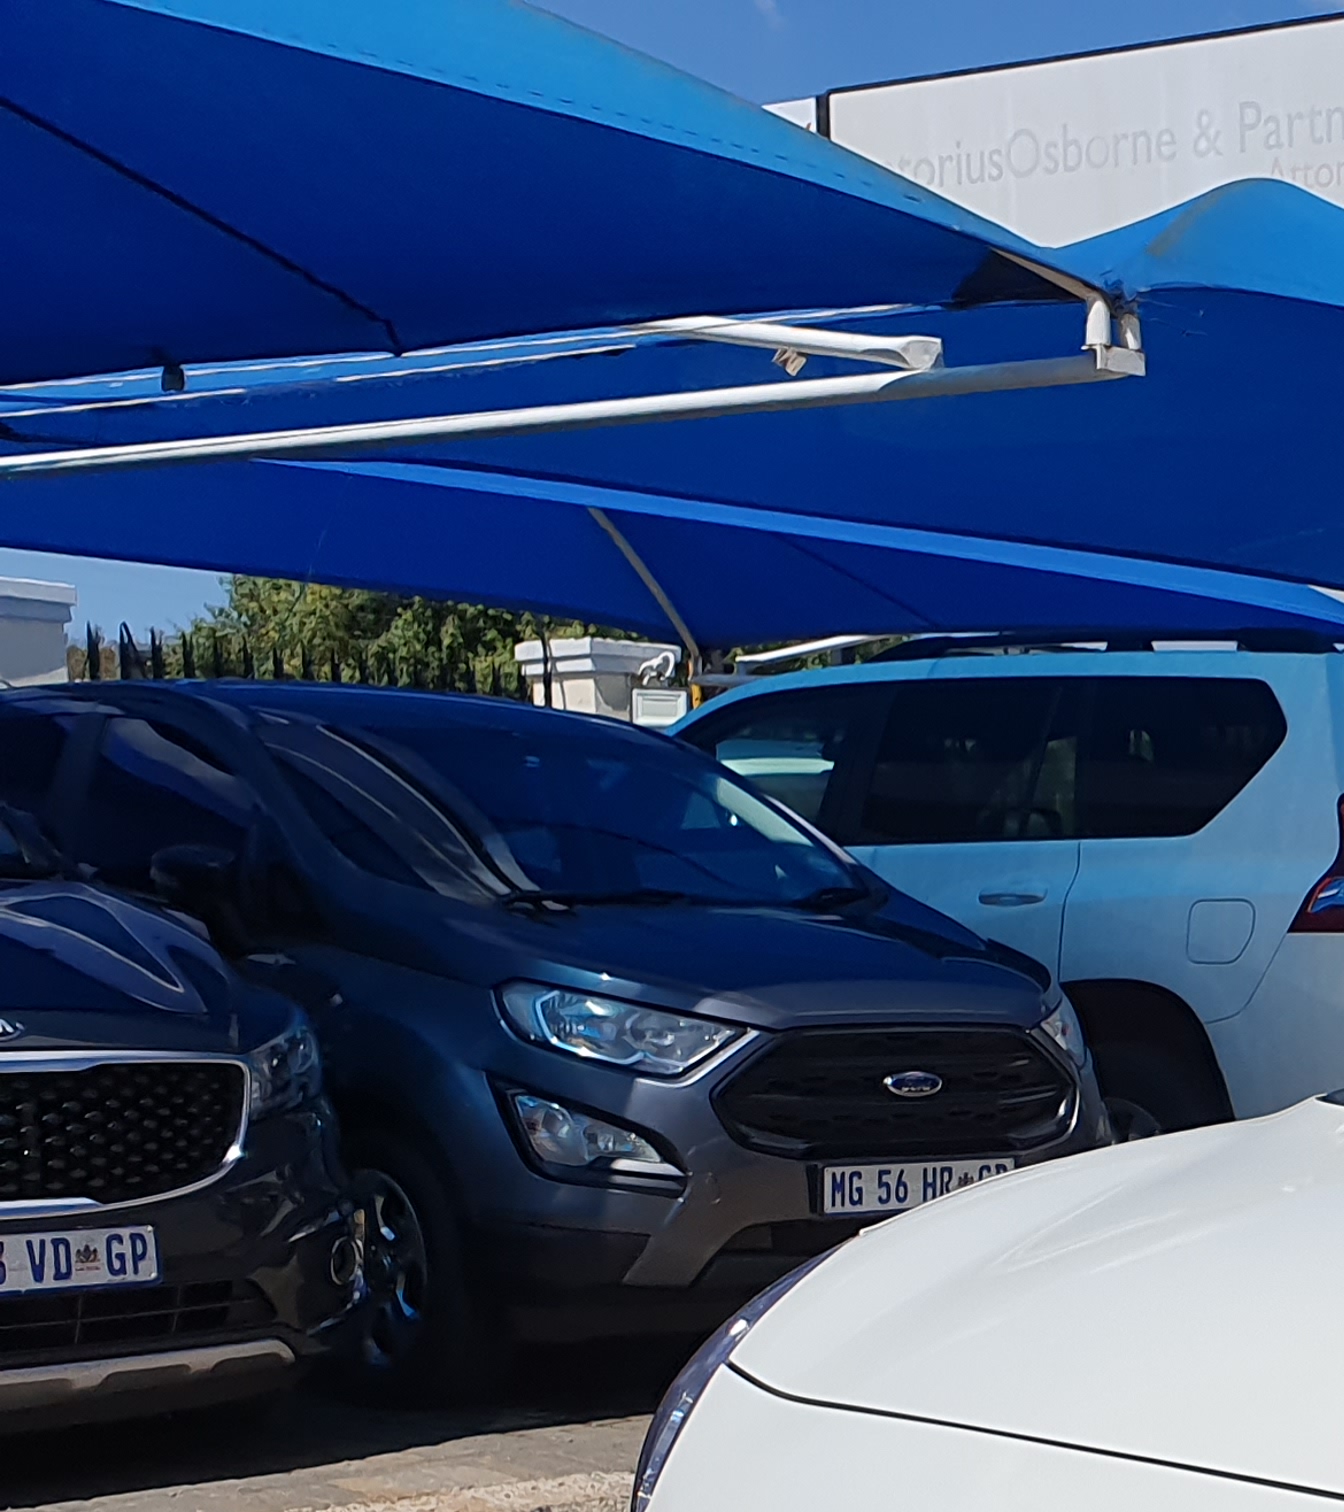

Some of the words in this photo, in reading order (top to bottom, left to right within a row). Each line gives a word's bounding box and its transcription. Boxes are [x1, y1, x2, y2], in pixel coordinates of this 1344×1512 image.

[1193, 108, 1224, 159] &
[831, 1170, 864, 1208] MG
[877, 1168, 909, 1205] 56
[922, 1166, 954, 1202] HR
[25, 1237, 73, 1284] VD
[105, 1232, 148, 1277] GP
